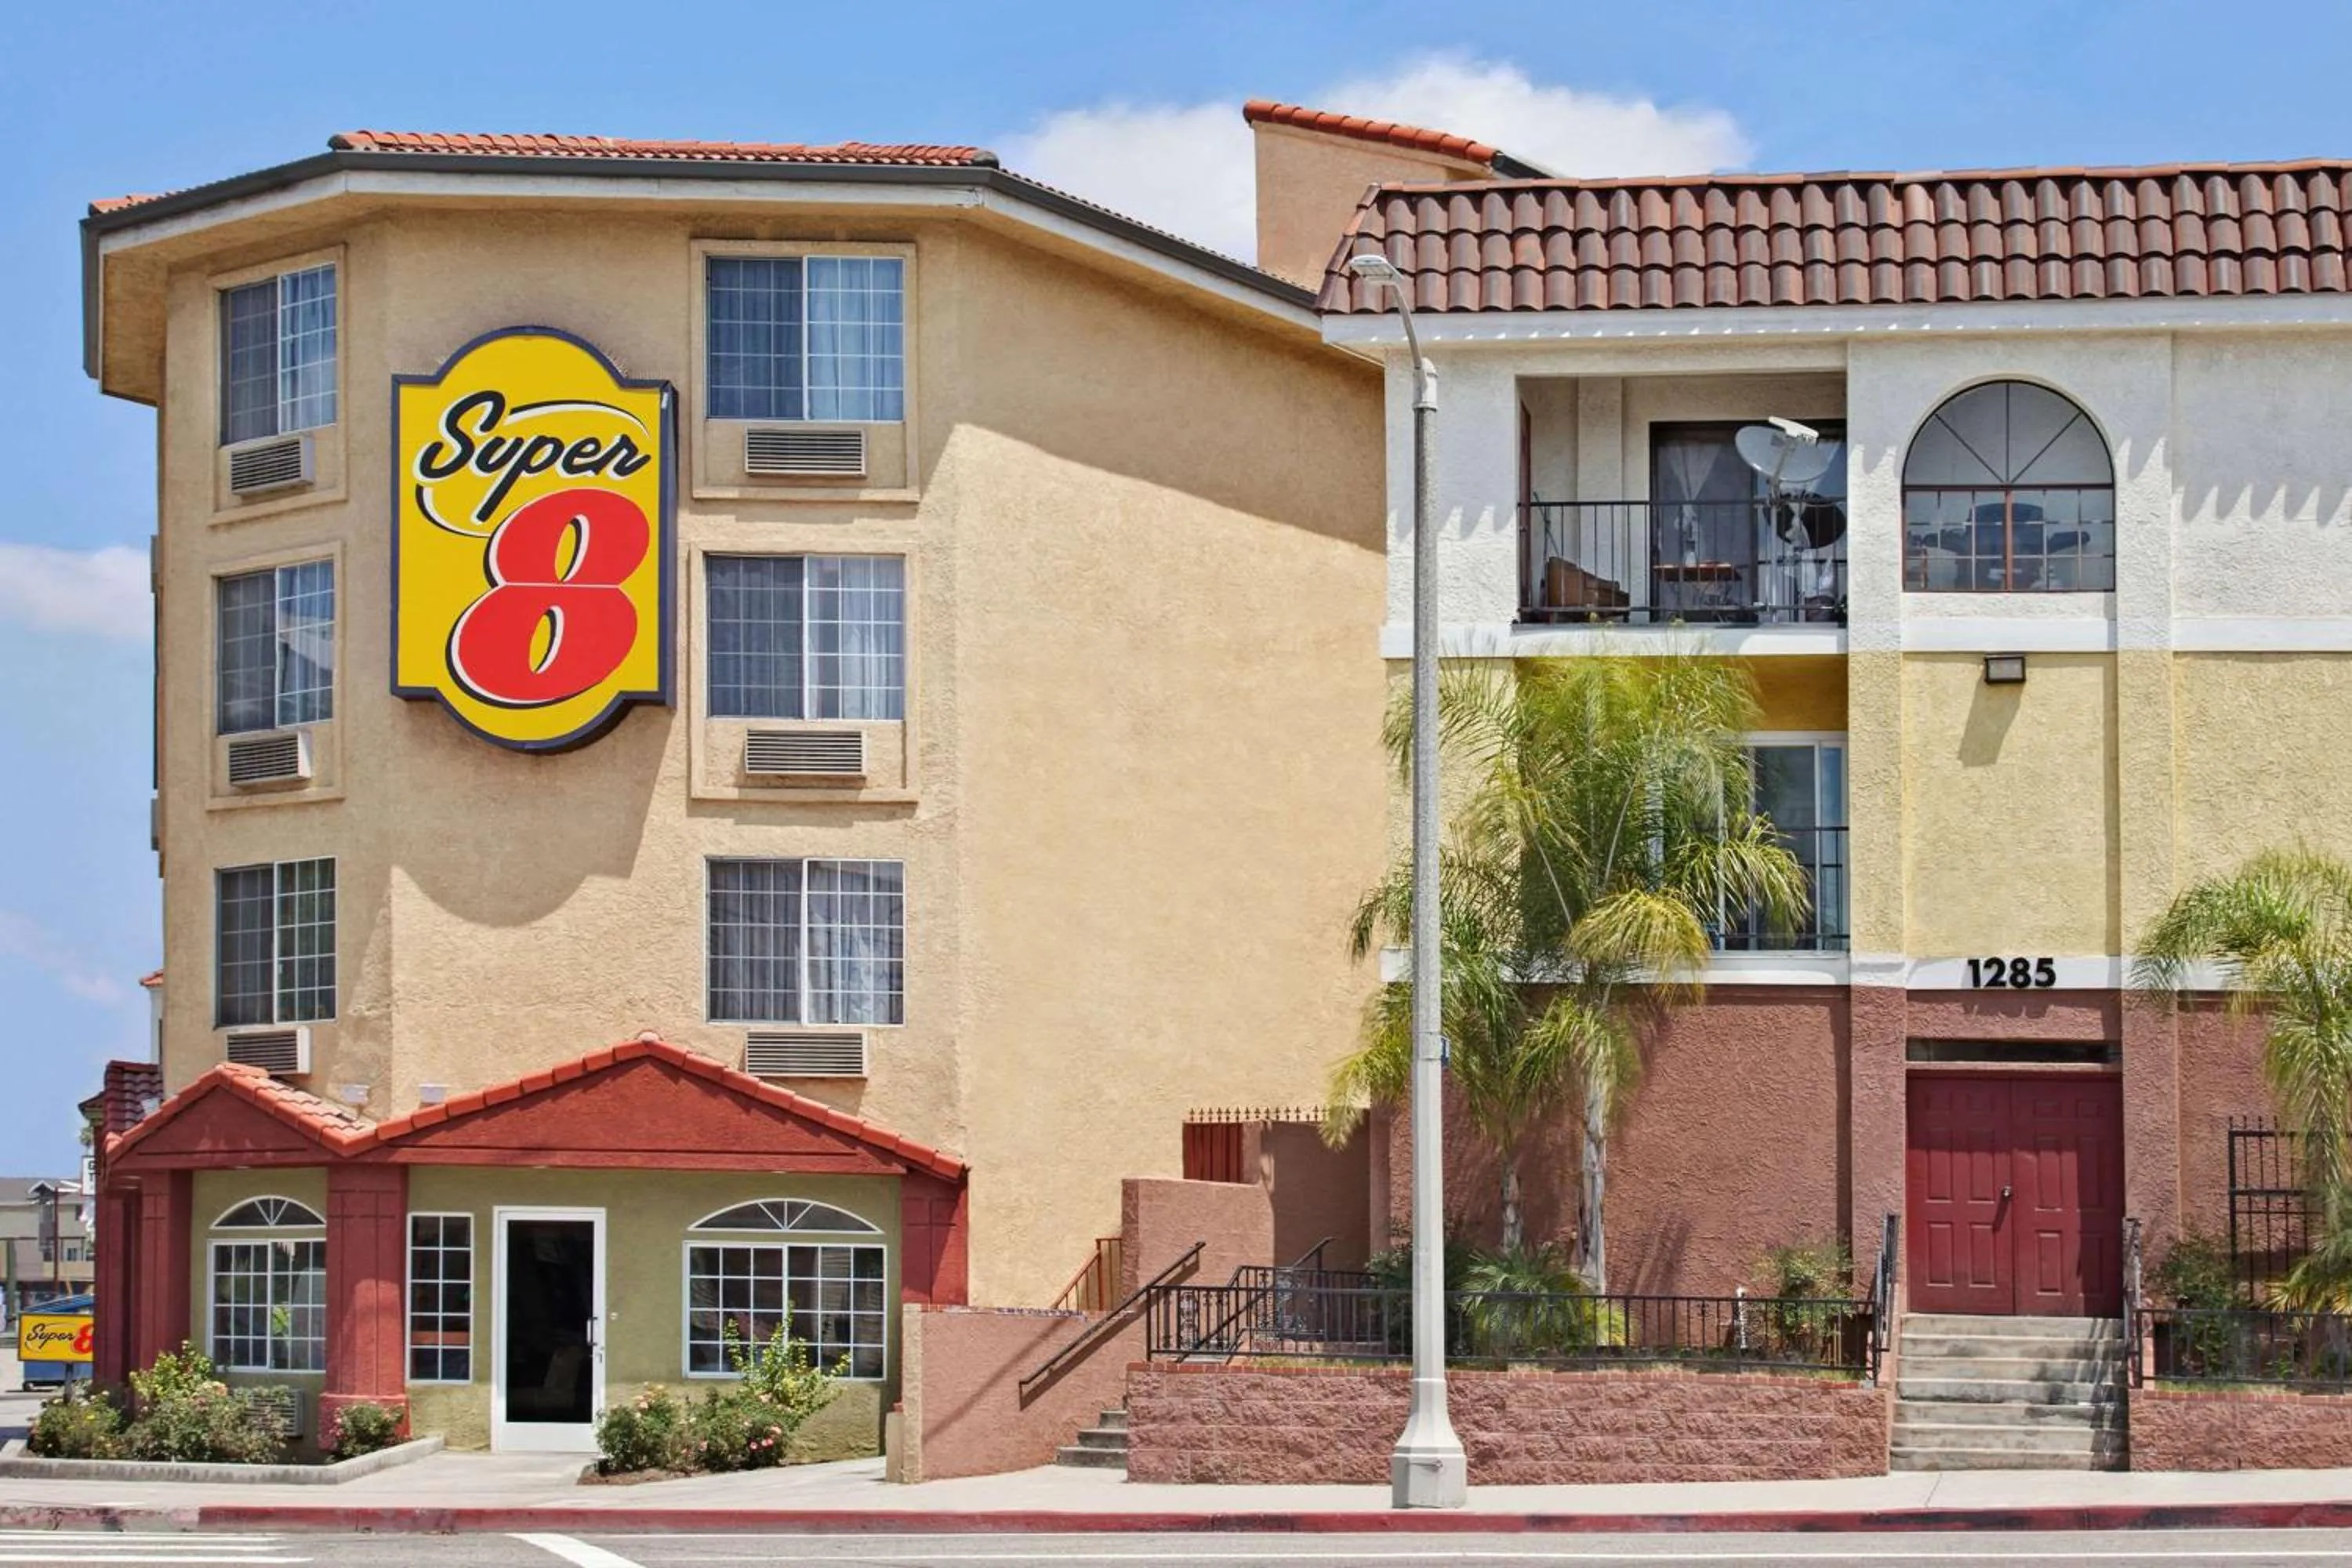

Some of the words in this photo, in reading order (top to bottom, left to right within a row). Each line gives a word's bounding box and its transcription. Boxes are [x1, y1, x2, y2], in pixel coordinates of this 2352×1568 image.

[415, 390, 652, 524] Super
[445, 487, 650, 708] 8
[1967, 956, 2056, 989] 1285
[26, 1323, 74, 1349] Super
